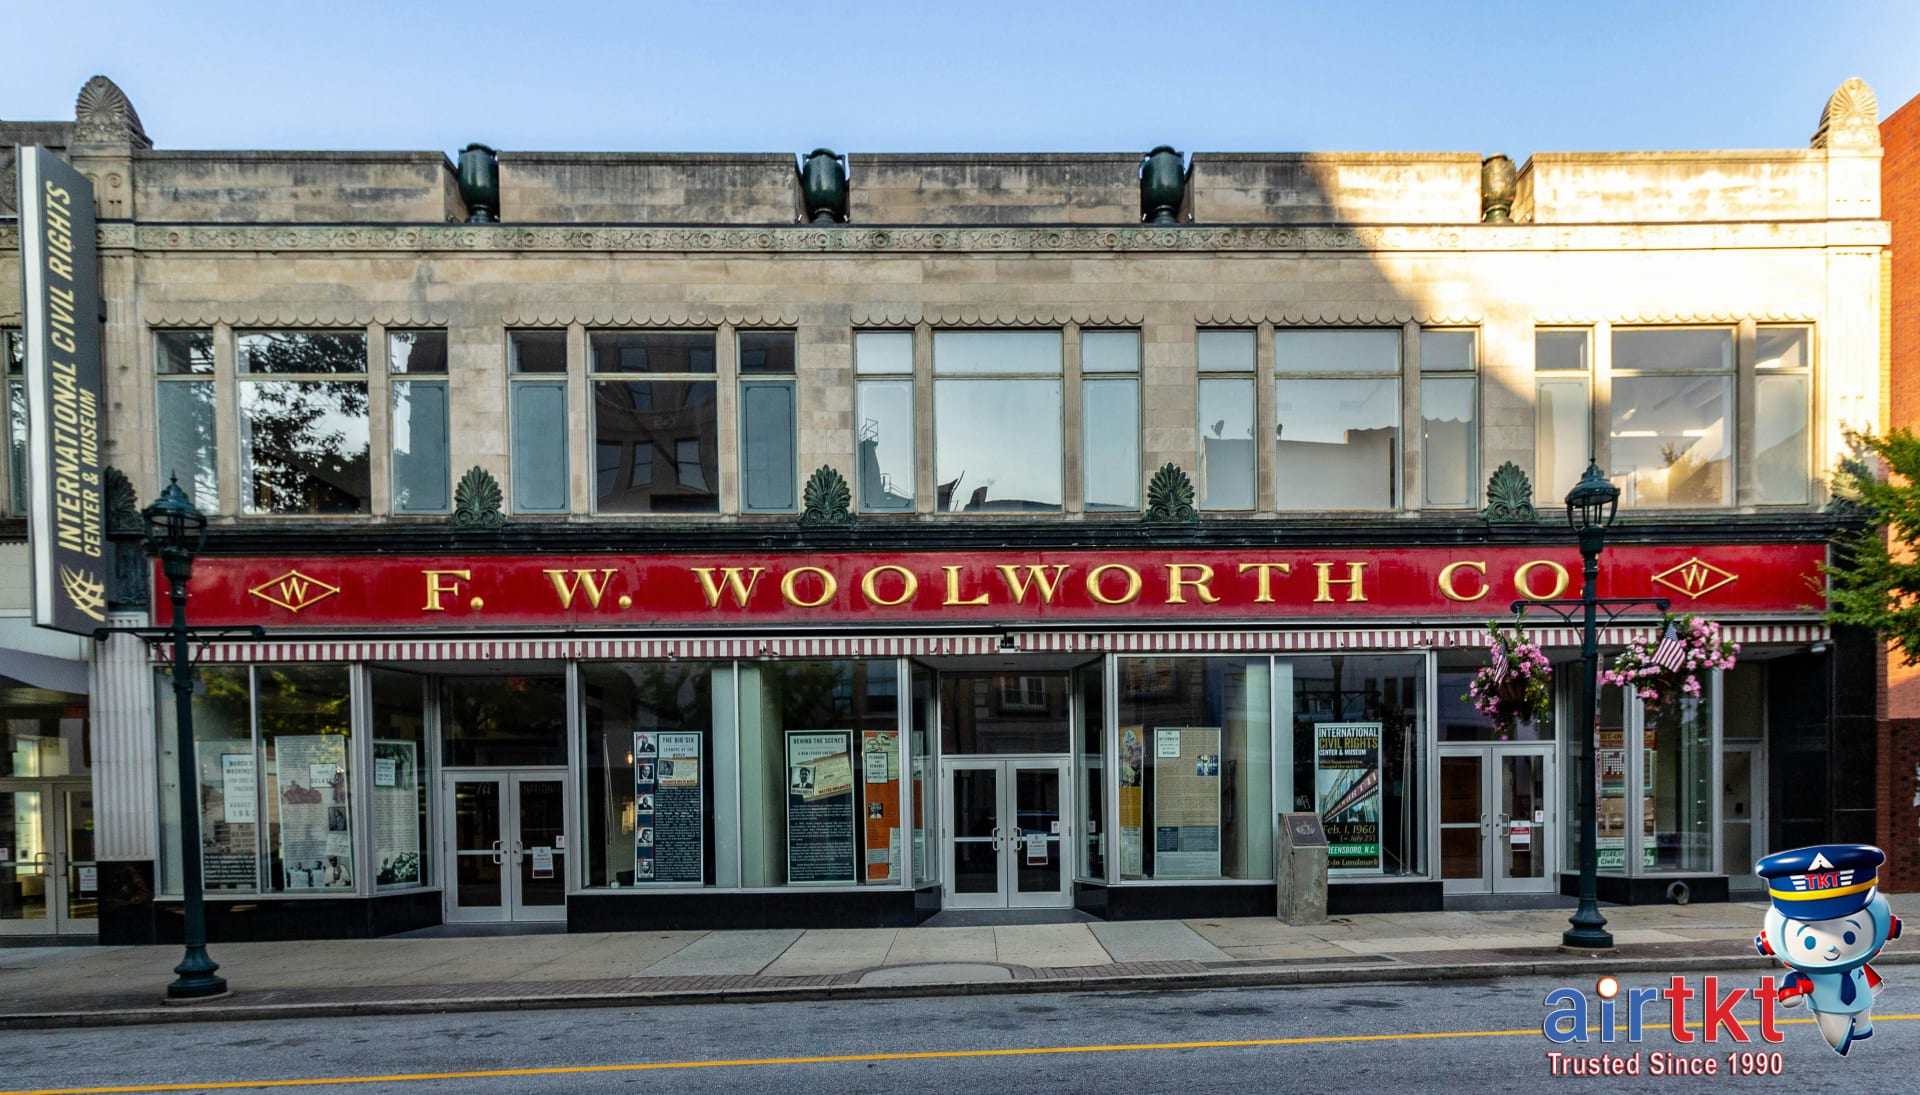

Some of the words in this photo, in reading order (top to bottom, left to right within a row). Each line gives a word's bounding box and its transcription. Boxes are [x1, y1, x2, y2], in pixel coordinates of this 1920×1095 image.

[46, 180, 74, 281] RIGHTS
[50, 286, 76, 353] CIVIL
[79, 388, 98, 468] MUSEUM
[52, 361, 83, 553] INTERNATIONAL
[82, 472, 99, 486] &
[82, 489, 102, 557] CENTER
[279, 577, 308, 605] W
[421, 569, 484, 612] F.
[542, 568, 632, 610] W.
[690, 561, 1368, 609] WOOLWORTH
[1438, 559, 1583, 601] CO
[1679, 565, 1708, 592] W
[1319, 728, 1378, 738] INTERNATIONAL
[1319, 738, 1342, 749] CIVIL
[1344, 737, 1378, 749] RIGHTS
[1352, 825, 1376, 834] 1960
[1328, 846, 1363, 855] REENSBORO,
